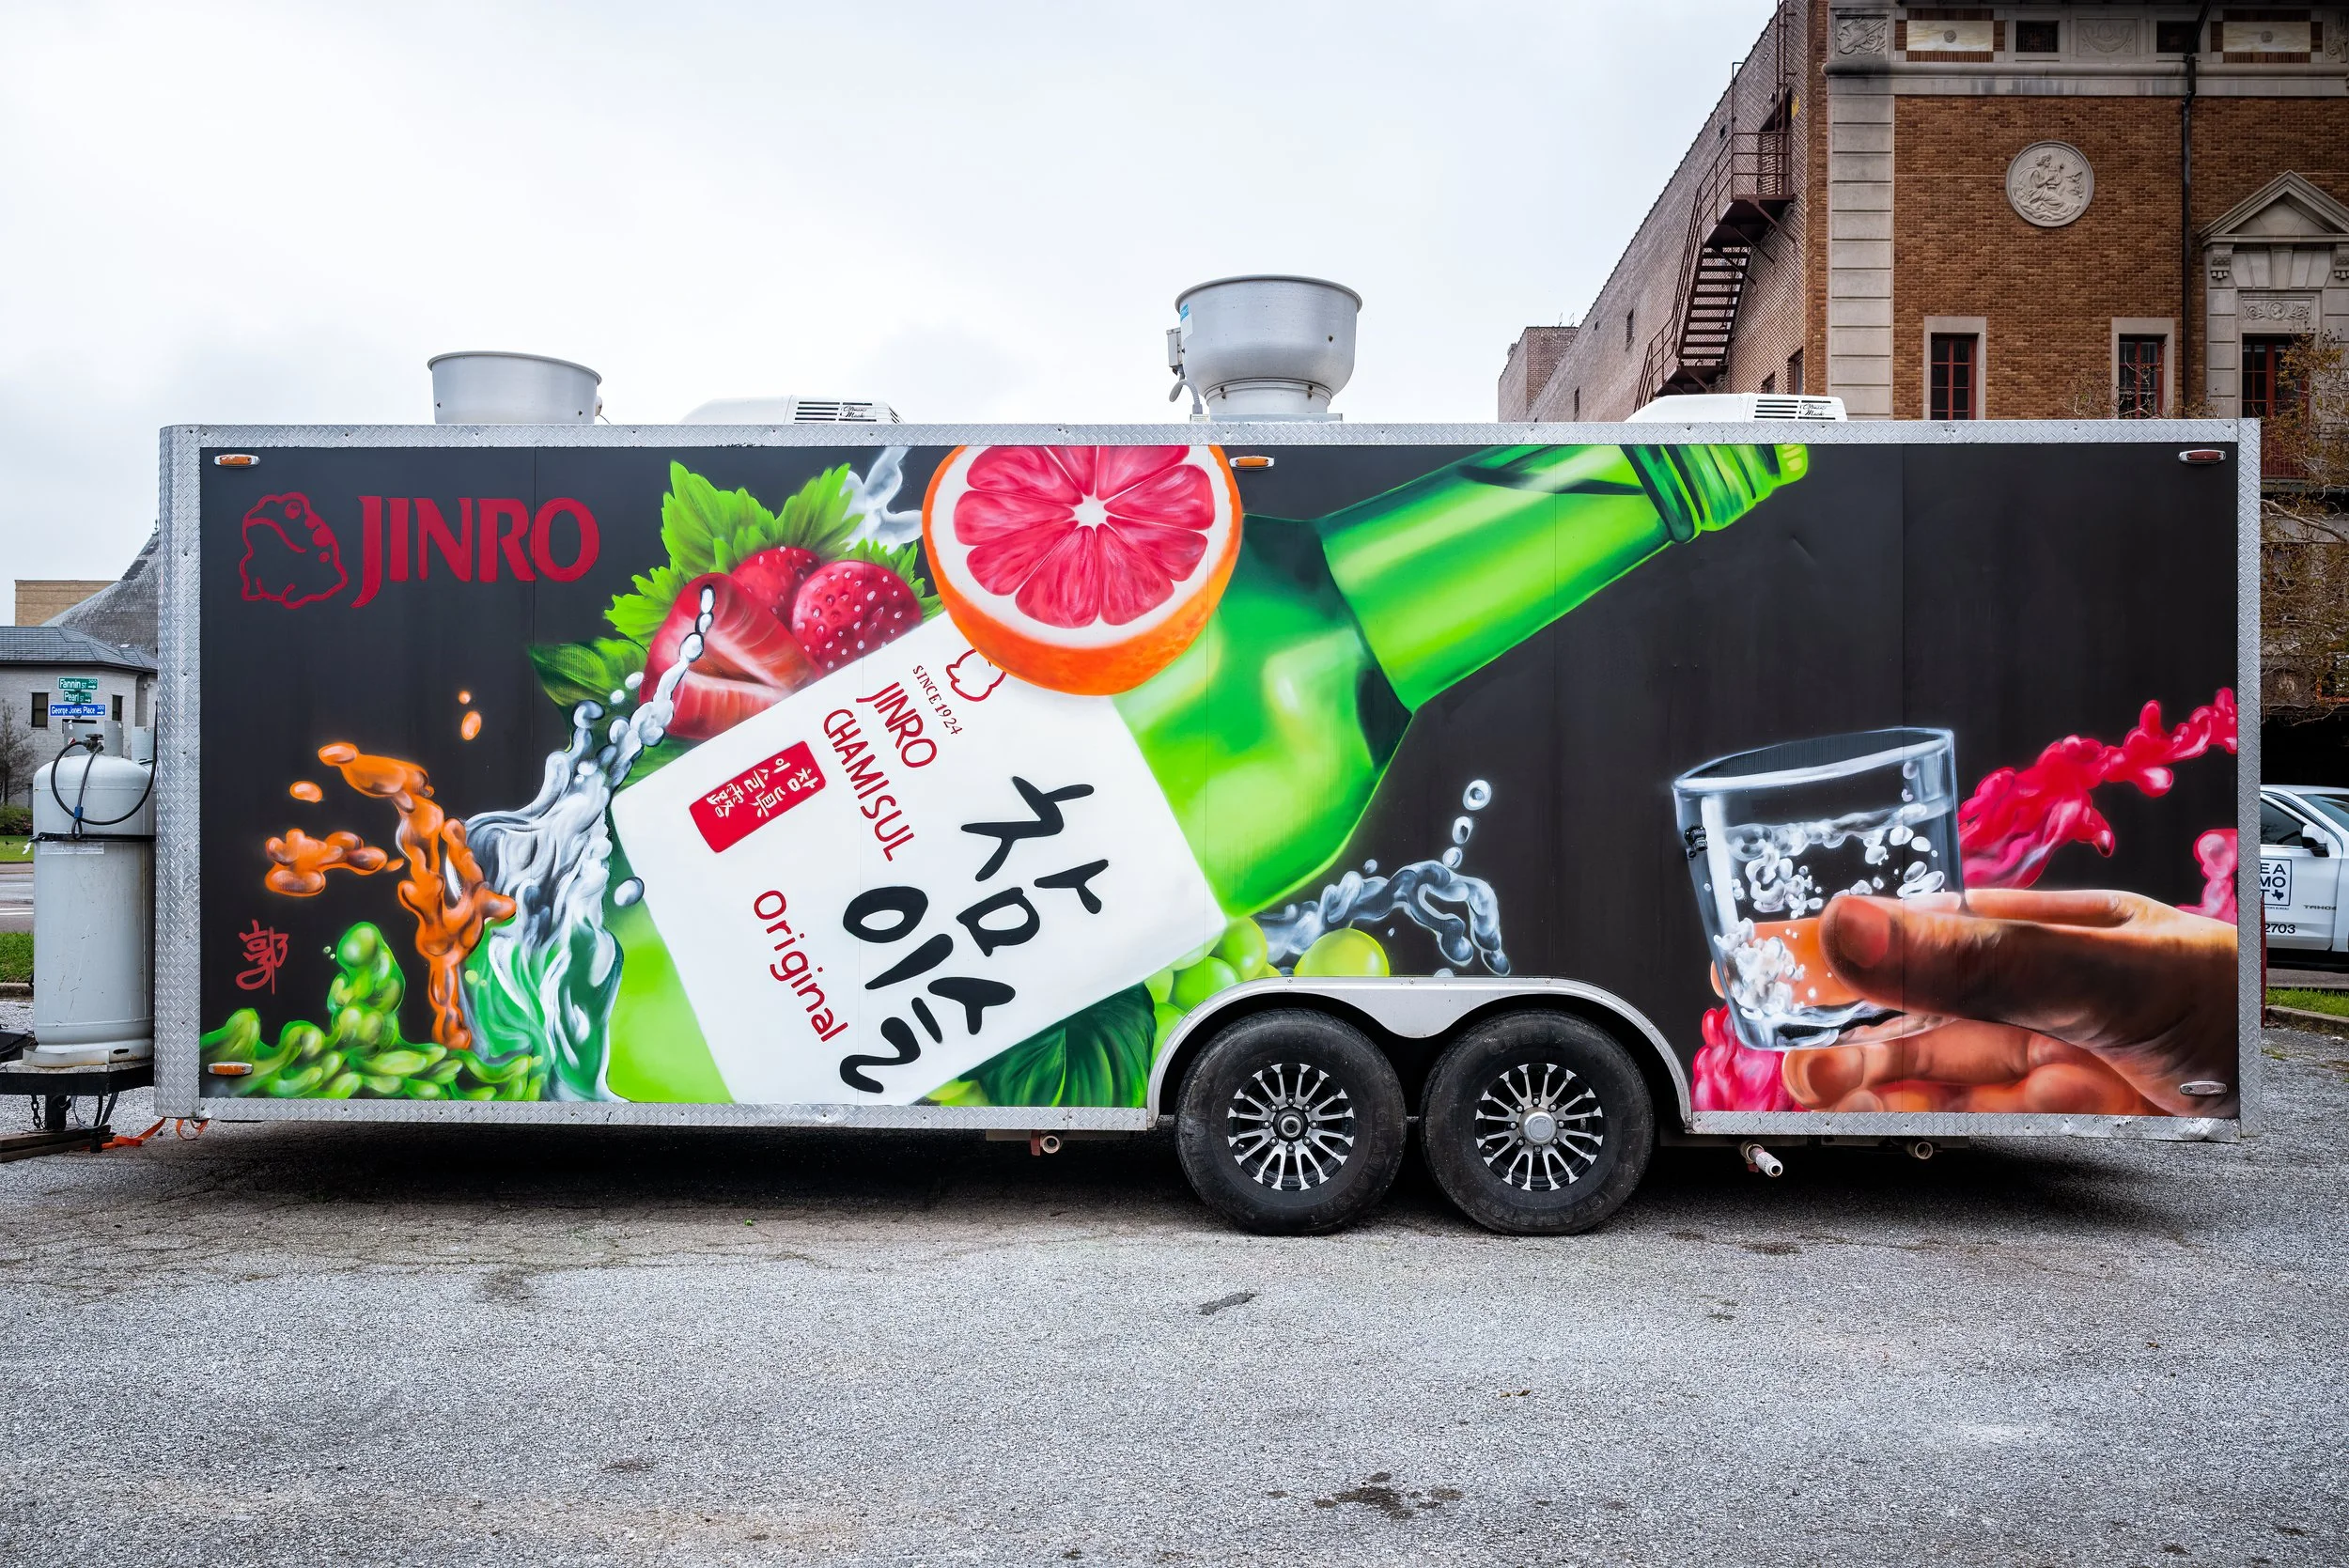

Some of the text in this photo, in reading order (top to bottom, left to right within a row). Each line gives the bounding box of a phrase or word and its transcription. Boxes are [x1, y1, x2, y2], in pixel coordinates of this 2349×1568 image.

[350, 496, 599, 609] JINRO
[51, 706, 68, 715] George
[59, 678, 81, 688] Fannin
[64, 691, 80, 702] Pearl
[912, 665, 963, 735] SINCE 1924
[856, 682, 937, 768] JINRO
[824, 709, 913, 862] CHAMISUL
[2260, 862, 2287, 875] EA
[754, 890, 848, 1042] Original
